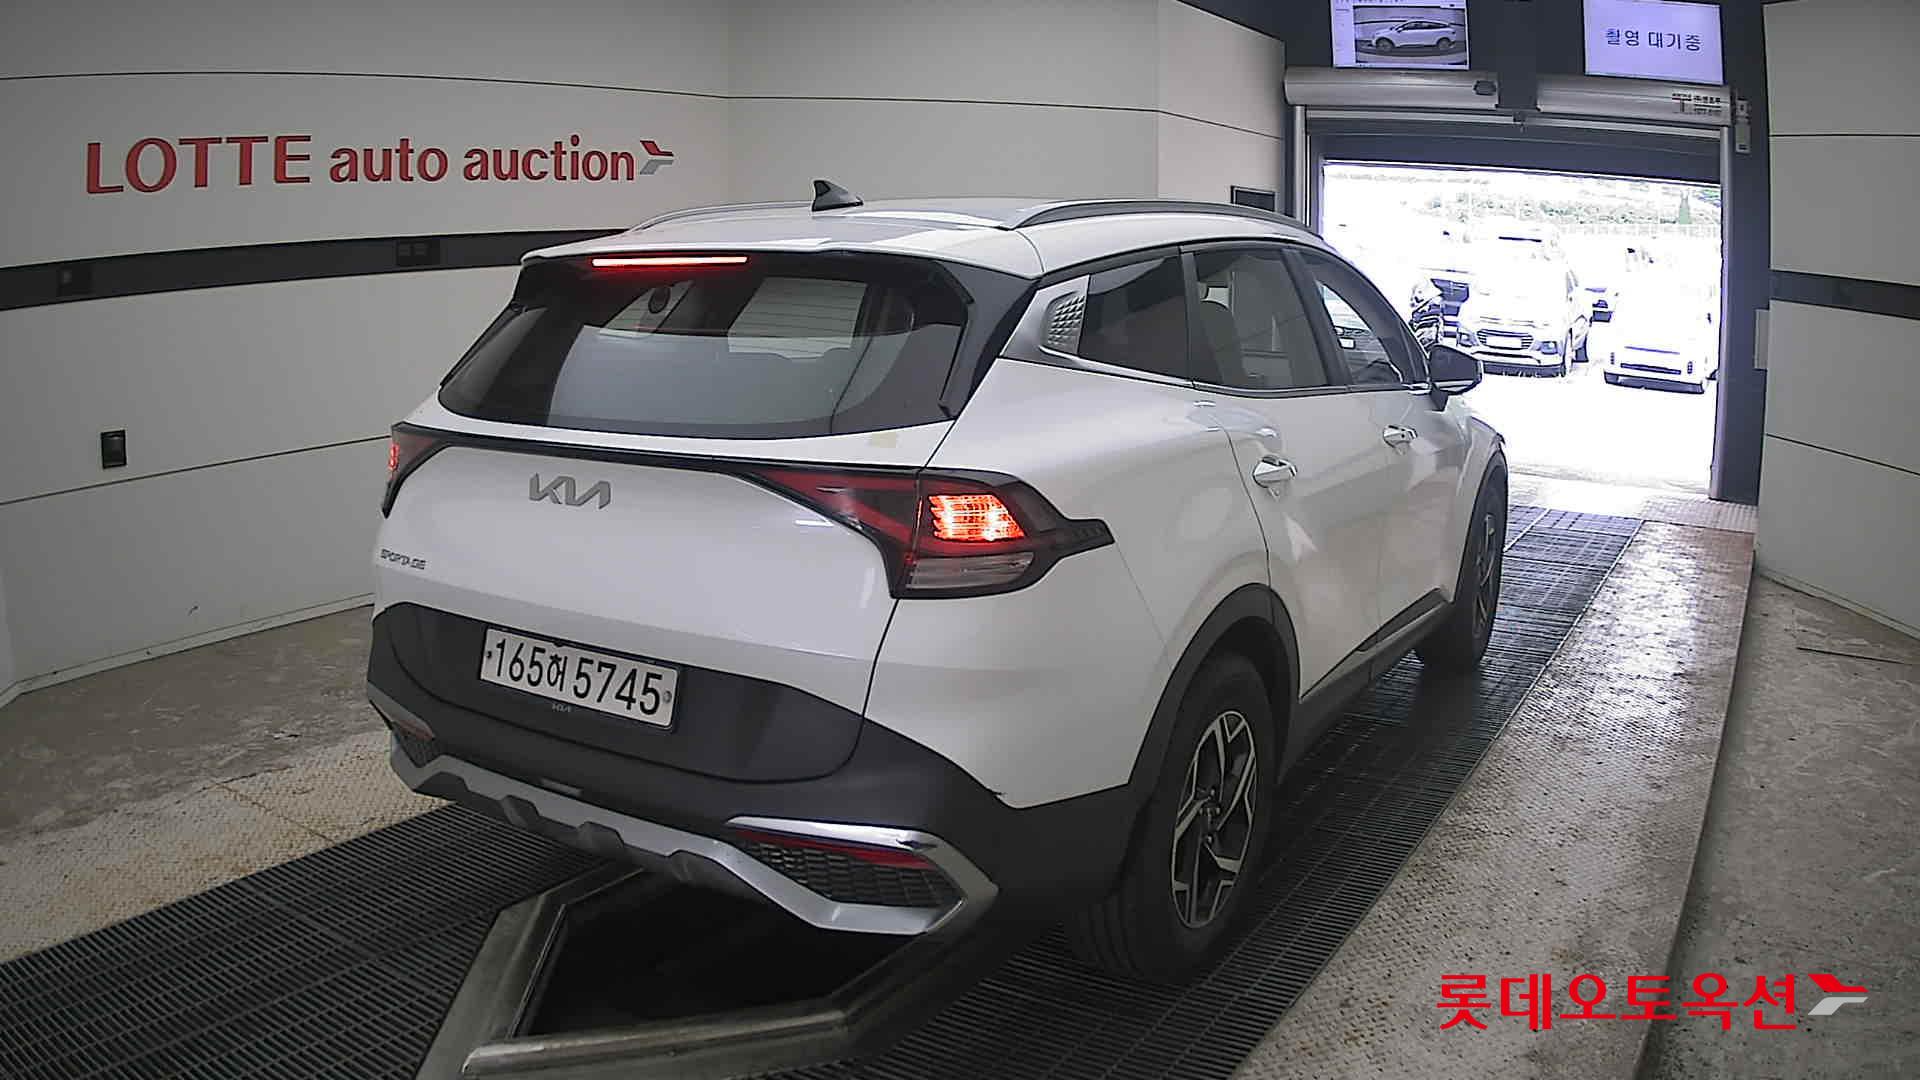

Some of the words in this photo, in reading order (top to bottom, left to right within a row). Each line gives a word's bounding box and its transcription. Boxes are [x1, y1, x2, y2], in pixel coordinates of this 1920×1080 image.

[1648, 31, 1701, 52] 대기중
[87, 135, 312, 194] LOTTE
[329, 138, 449, 182] auto
[463, 134, 635, 182] auction
[529, 473, 612, 510] KIA
